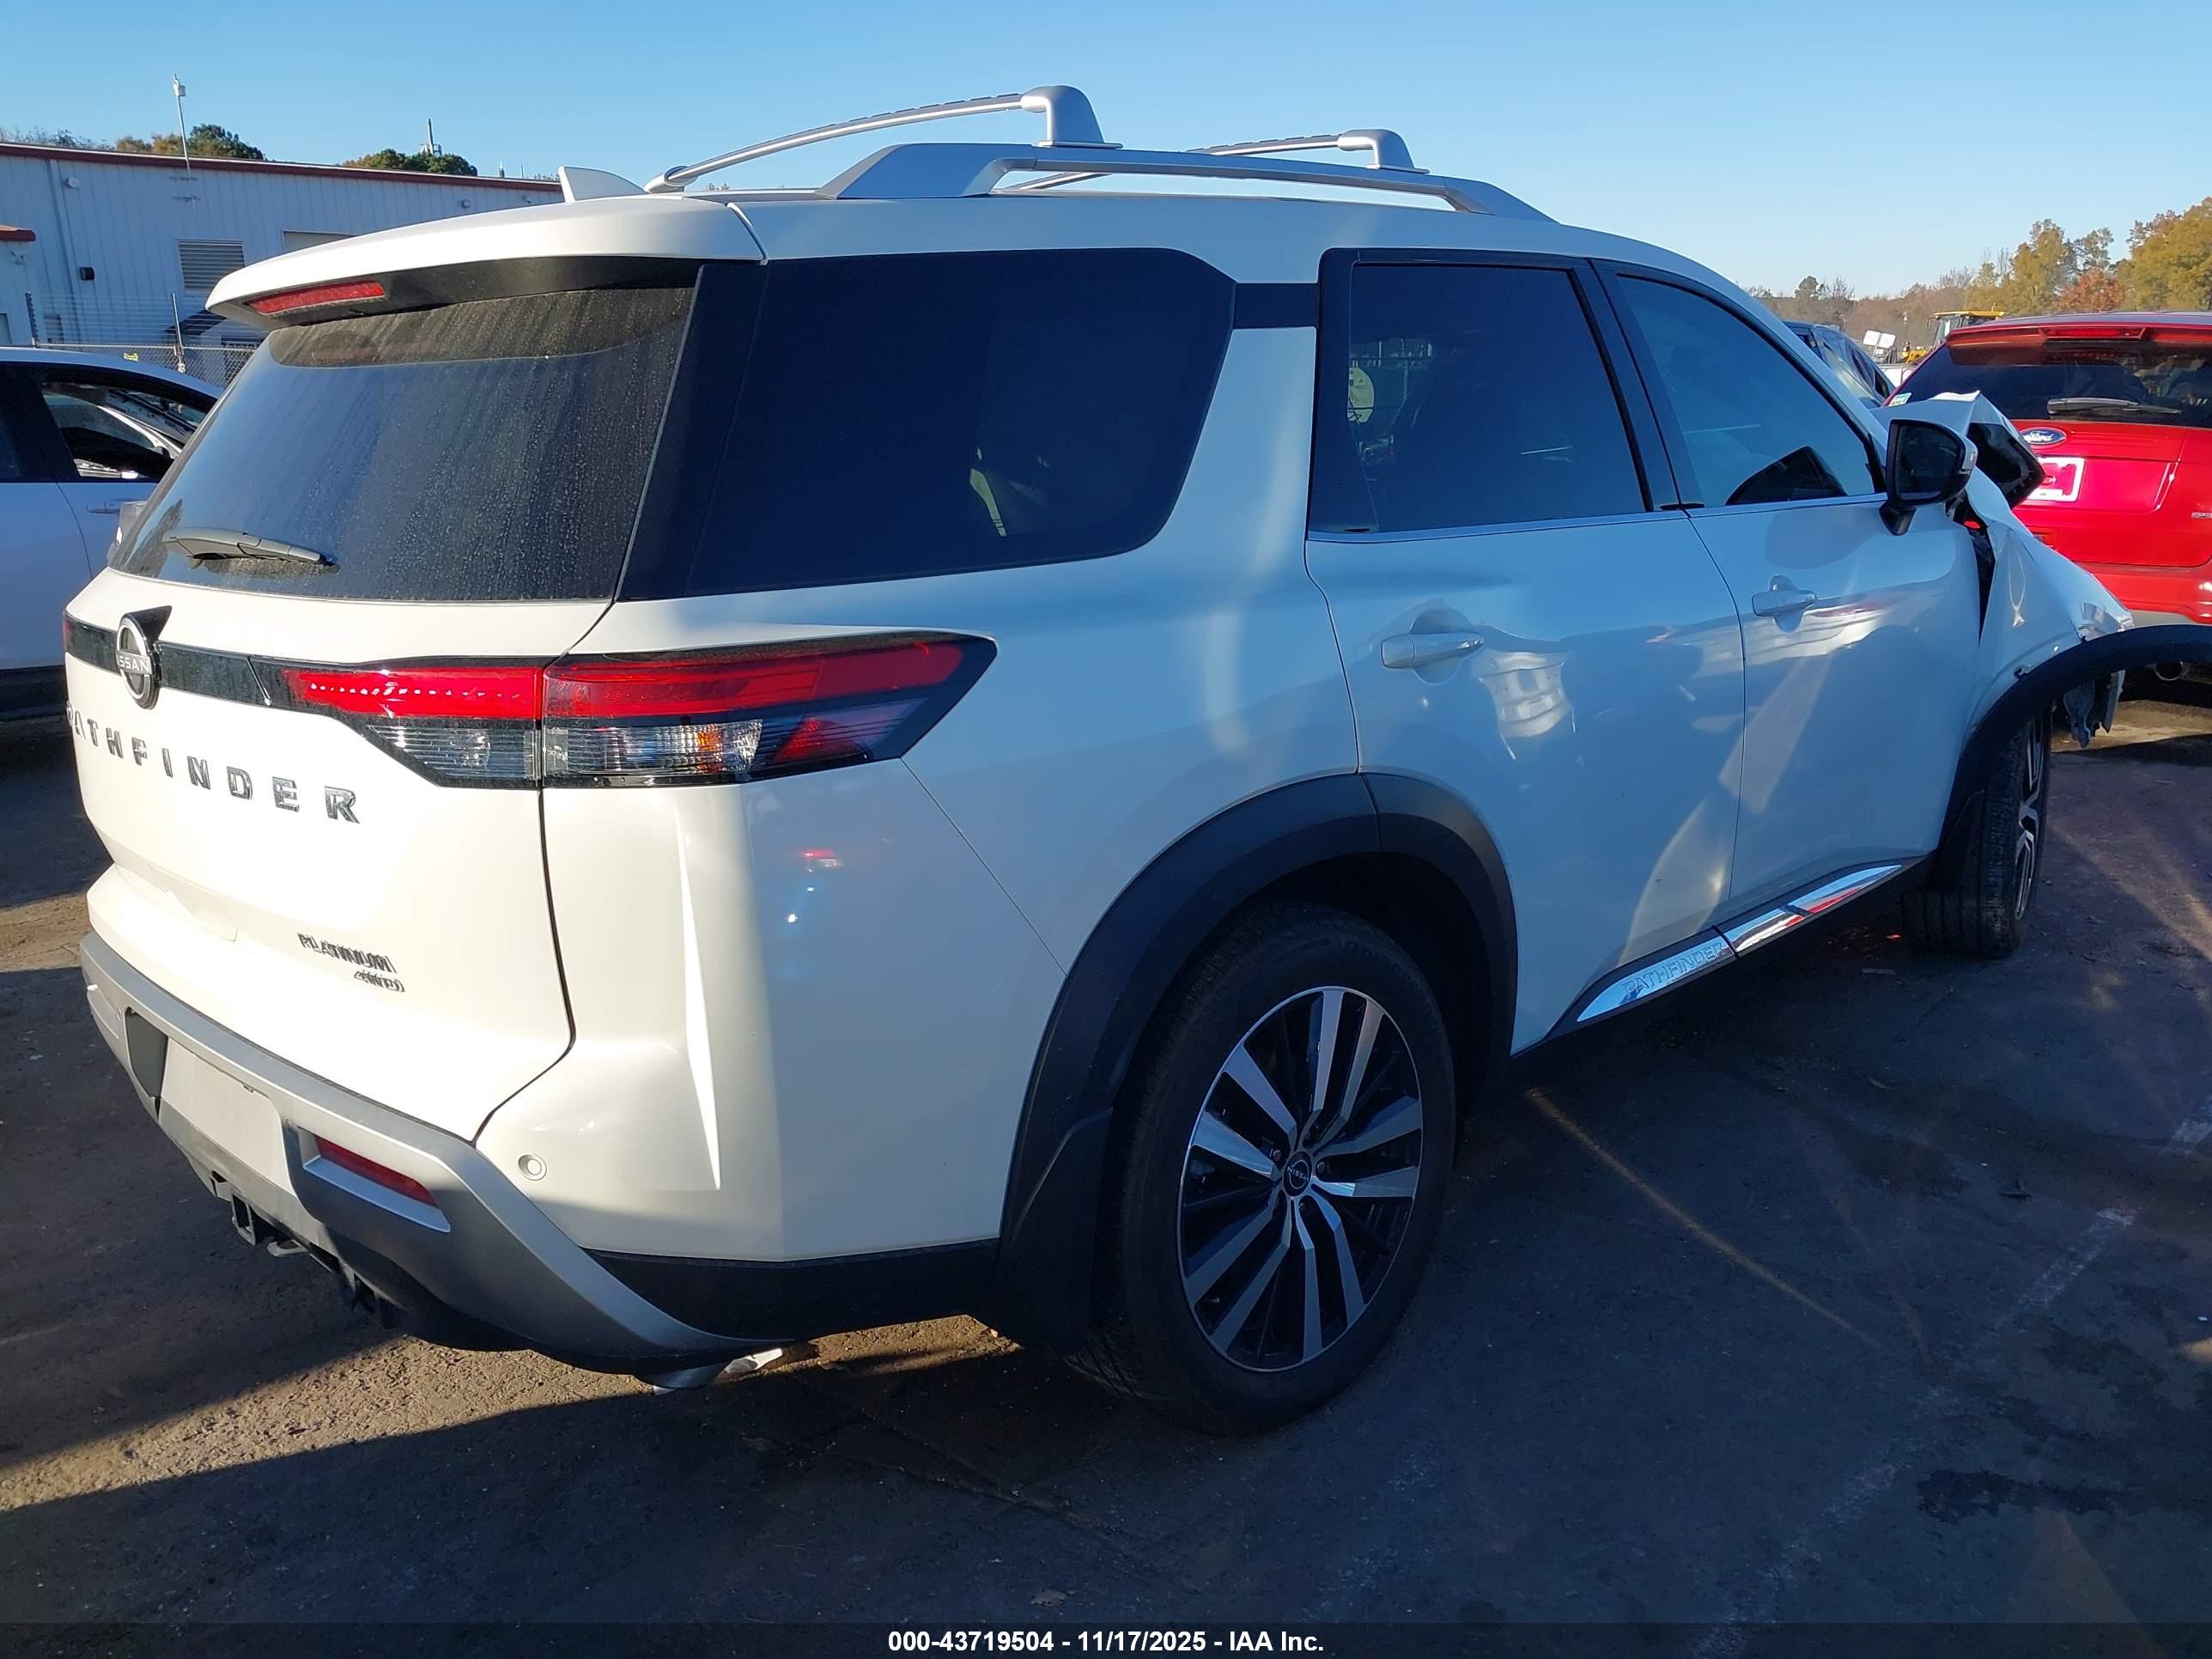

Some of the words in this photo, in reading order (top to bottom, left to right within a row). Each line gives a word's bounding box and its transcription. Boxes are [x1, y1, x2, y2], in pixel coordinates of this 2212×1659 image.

[2023, 431, 2055, 442] Ford
[297, 933, 398, 974] PLATINUM
[1621, 942, 1723, 994] PATHFINDER
